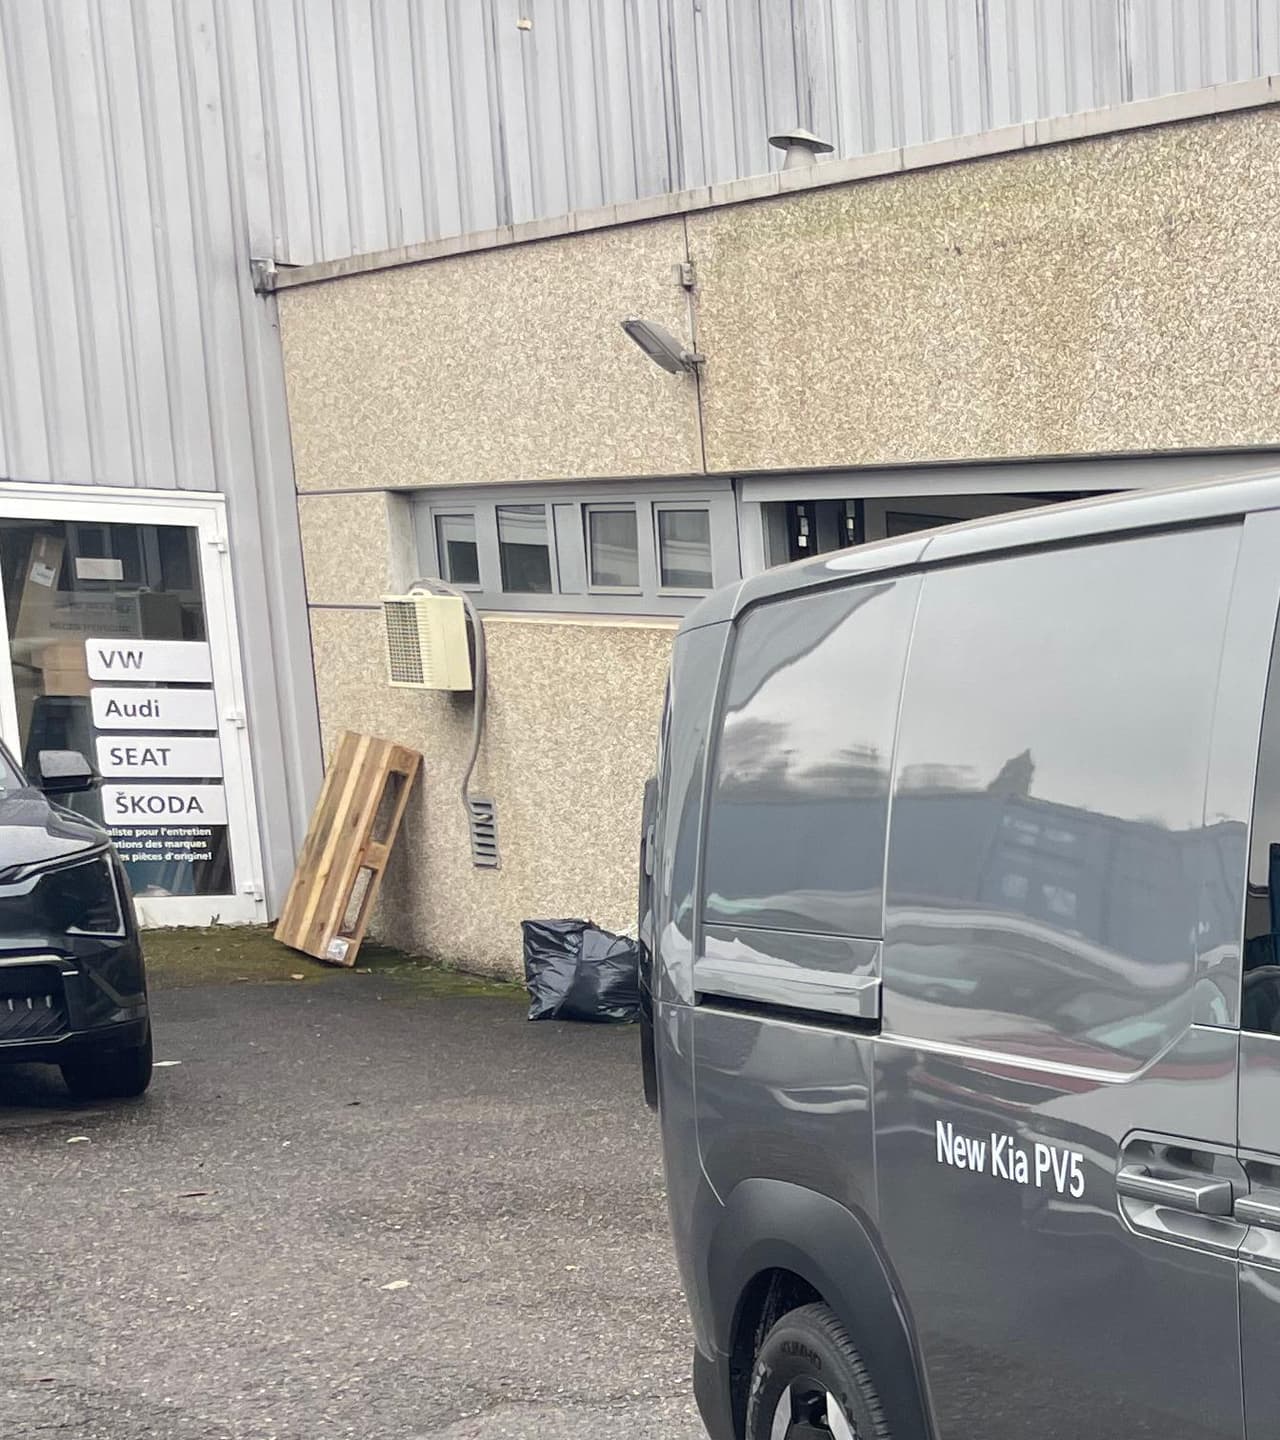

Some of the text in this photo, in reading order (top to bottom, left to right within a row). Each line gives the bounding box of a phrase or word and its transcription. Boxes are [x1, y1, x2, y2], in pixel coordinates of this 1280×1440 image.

[98, 650, 144, 669] VW
[105, 699, 160, 718] Audi
[110, 748, 171, 766] SEAT
[116, 792, 204, 814] ŠKODA
[135, 828, 159, 838] pour
[160, 827, 212, 837] l'entretien
[145, 840, 163, 849] des
[165, 840, 207, 850] marques
[935, 1119, 1086, 1199] New Kia PV5
